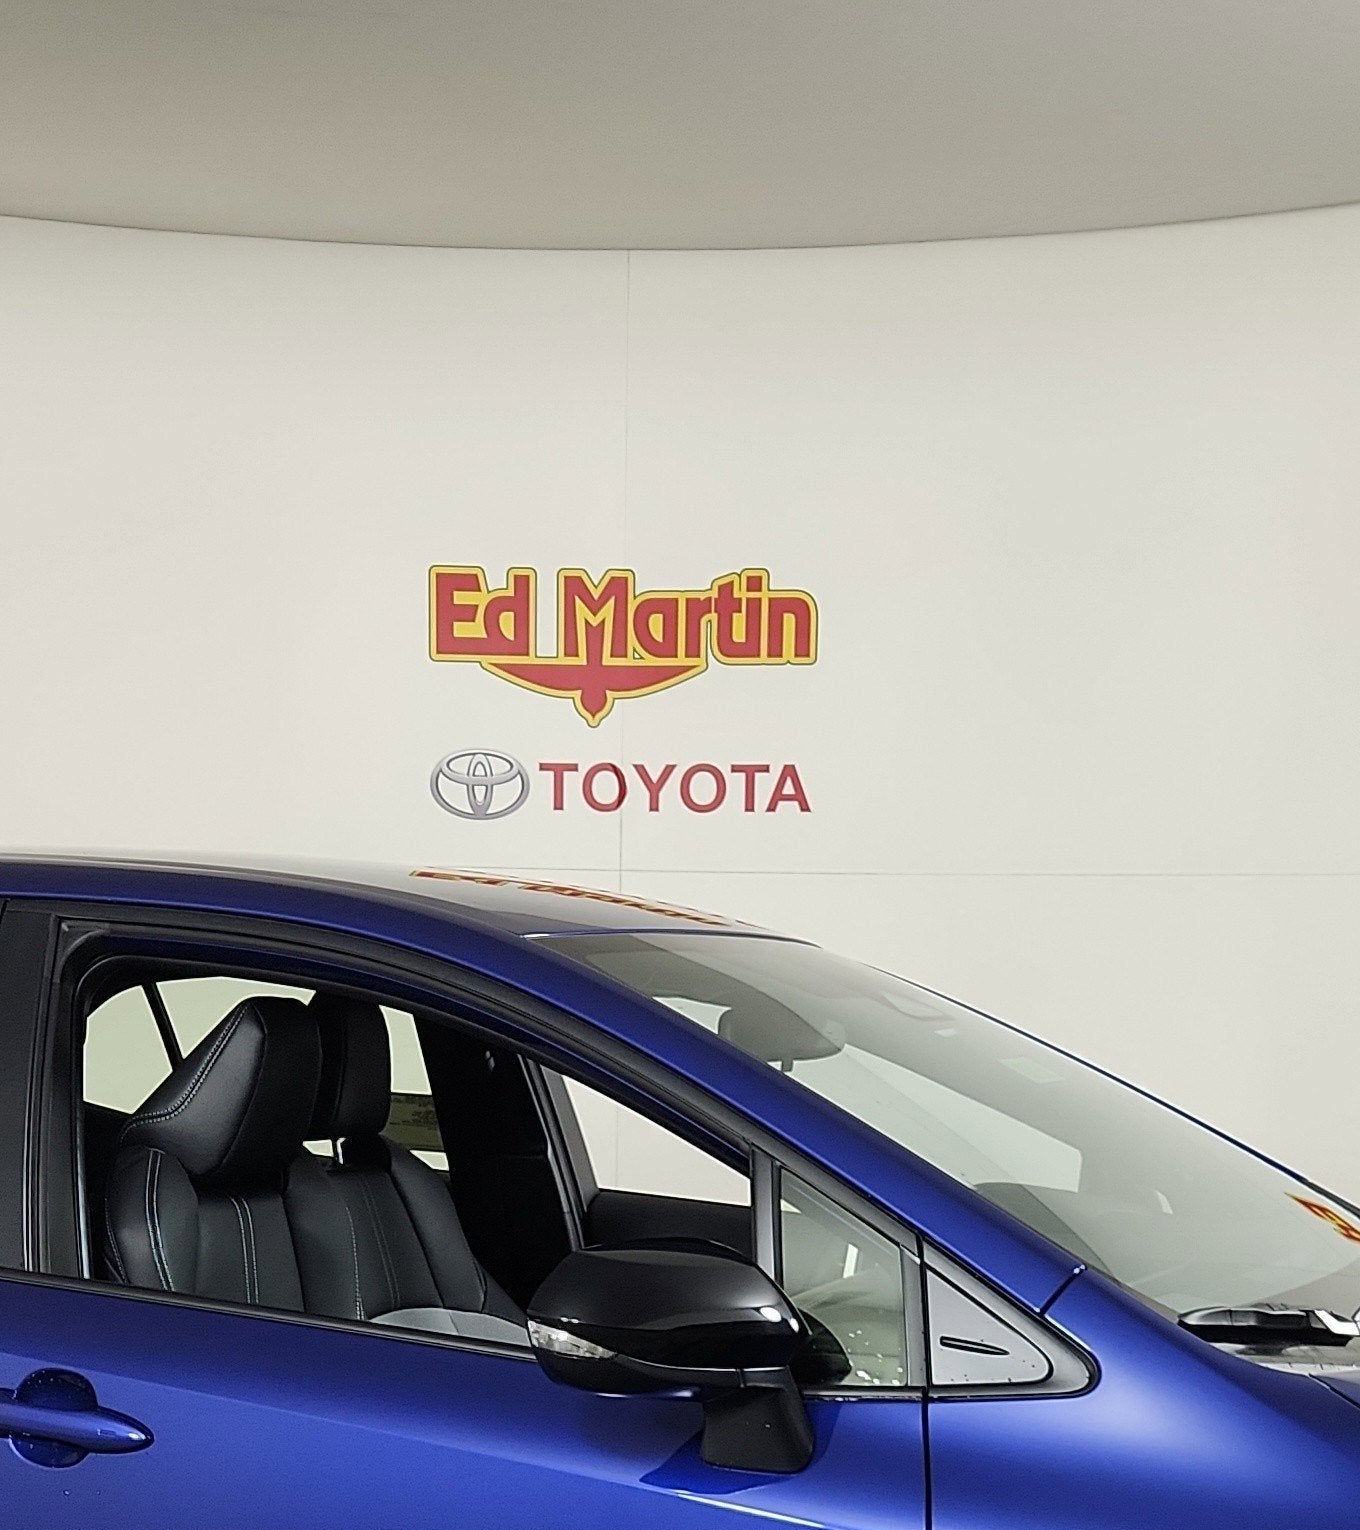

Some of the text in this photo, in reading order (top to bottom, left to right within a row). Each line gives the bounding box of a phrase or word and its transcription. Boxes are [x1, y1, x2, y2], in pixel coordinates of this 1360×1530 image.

[434, 571, 812, 661] Ed Martin
[538, 761, 812, 813] TOYOTA
